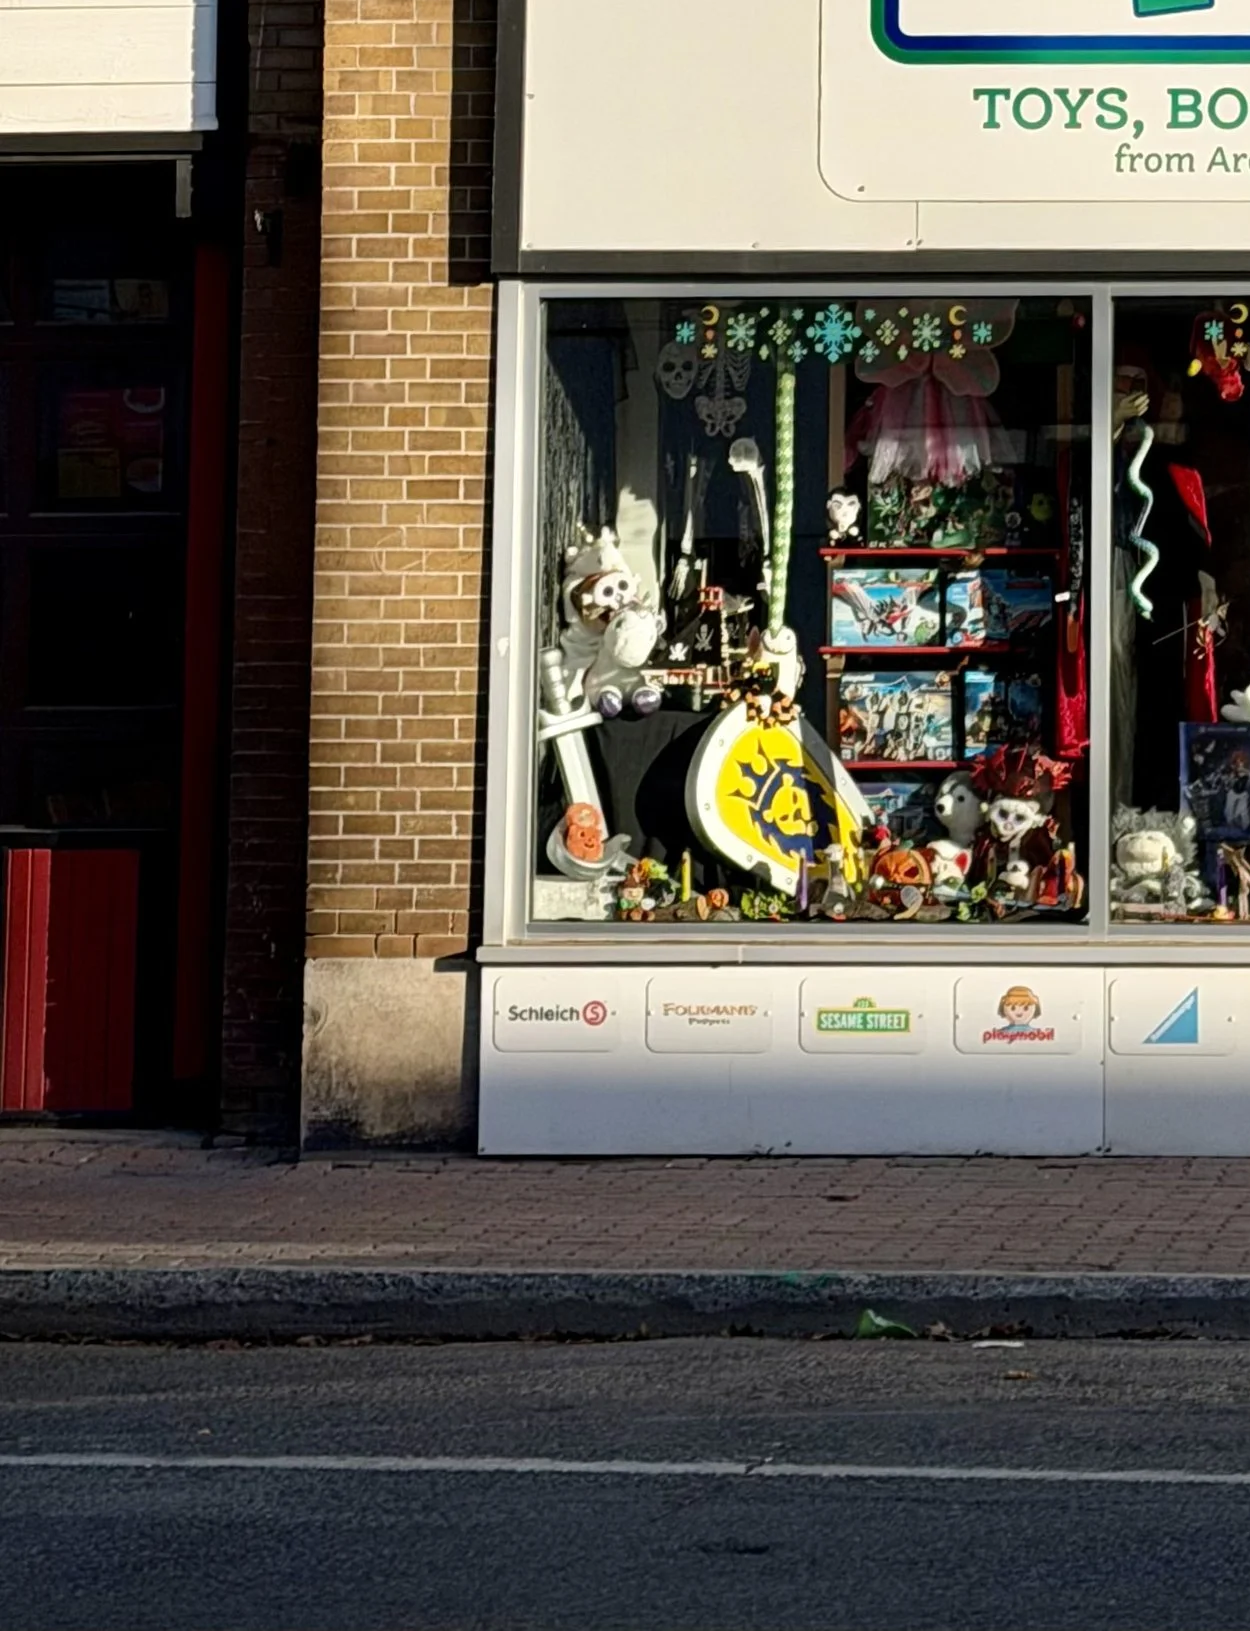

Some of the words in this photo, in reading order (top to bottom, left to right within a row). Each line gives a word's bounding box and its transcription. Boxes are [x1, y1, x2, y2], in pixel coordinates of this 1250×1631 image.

[973, 87, 1144, 139] TOYS,
[1114, 143, 1195, 173] from
[508, 1004, 580, 1022] Schleich
[820, 1013, 865, 1029] SESAME
[866, 1013, 906, 1029] STREET
[983, 1027, 1054, 1044] playmobil
